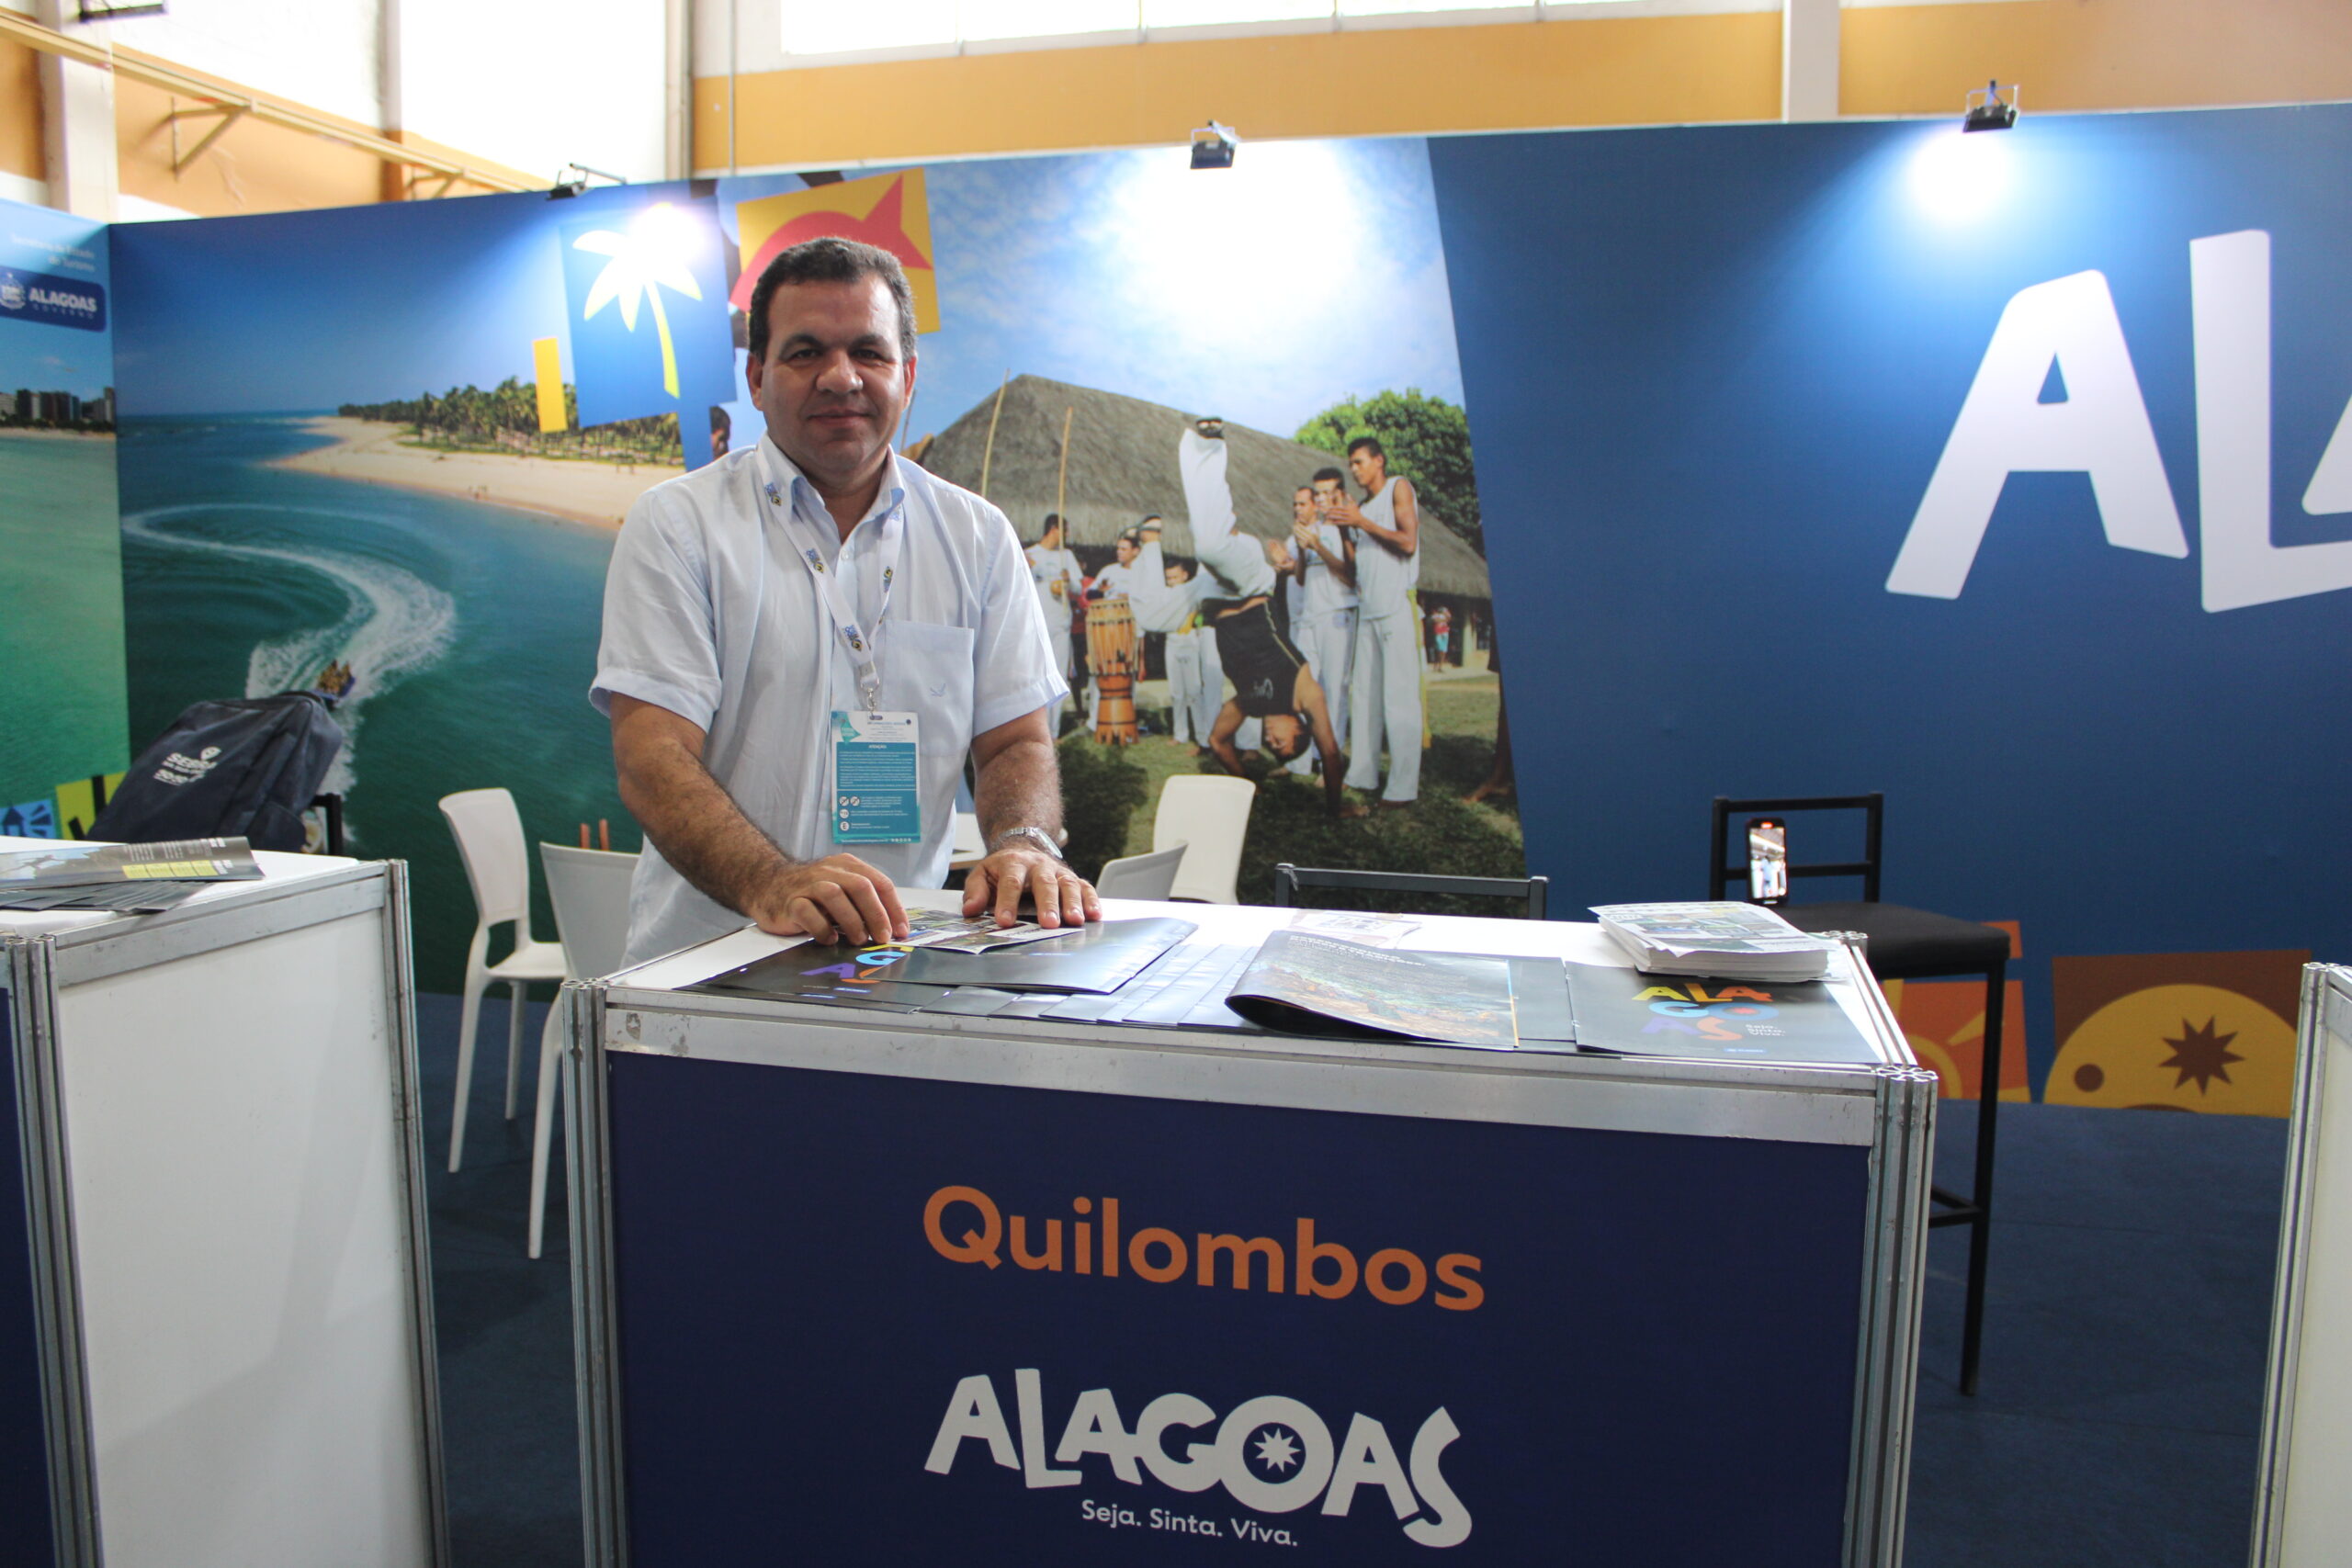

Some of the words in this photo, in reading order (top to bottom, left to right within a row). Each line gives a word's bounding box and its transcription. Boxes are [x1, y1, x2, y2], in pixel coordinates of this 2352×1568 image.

[28, 287, 97, 312] ALAGOAS
[923, 1185, 1485, 1311] Quilombos
[924, 1368, 1472, 1548] ALAGOAS
[1081, 1499, 1142, 1529] Seja.
[1149, 1508, 1223, 1537] Sinta.
[1230, 1518, 1298, 1546] Viva.
